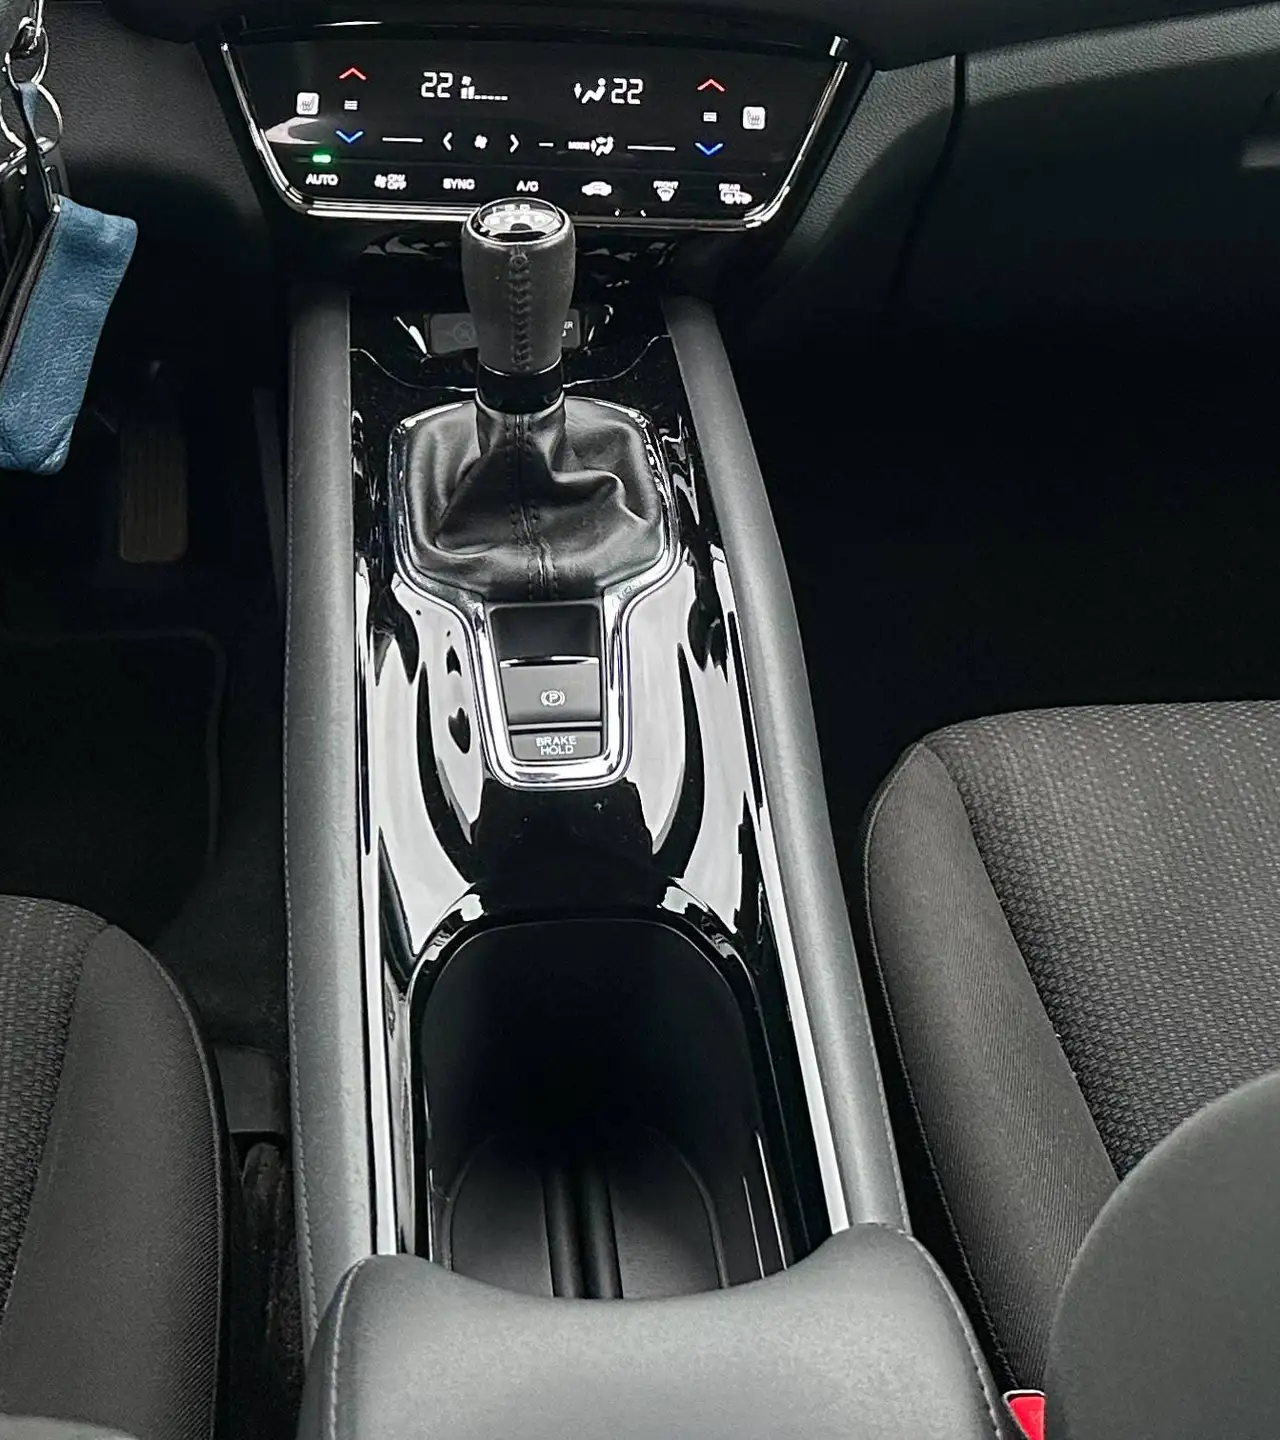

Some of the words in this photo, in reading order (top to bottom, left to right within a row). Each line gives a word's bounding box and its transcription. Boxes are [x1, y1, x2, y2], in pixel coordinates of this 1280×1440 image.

[420, 71, 453, 98] 22
[610, 77, 644, 105] 22
[306, 173, 339, 186] AUTO
[443, 178, 476, 190] SYNC
[516, 180, 540, 192] A/C
[536, 735, 577, 747] BRAKE
[540, 745, 574, 756] HOLD
